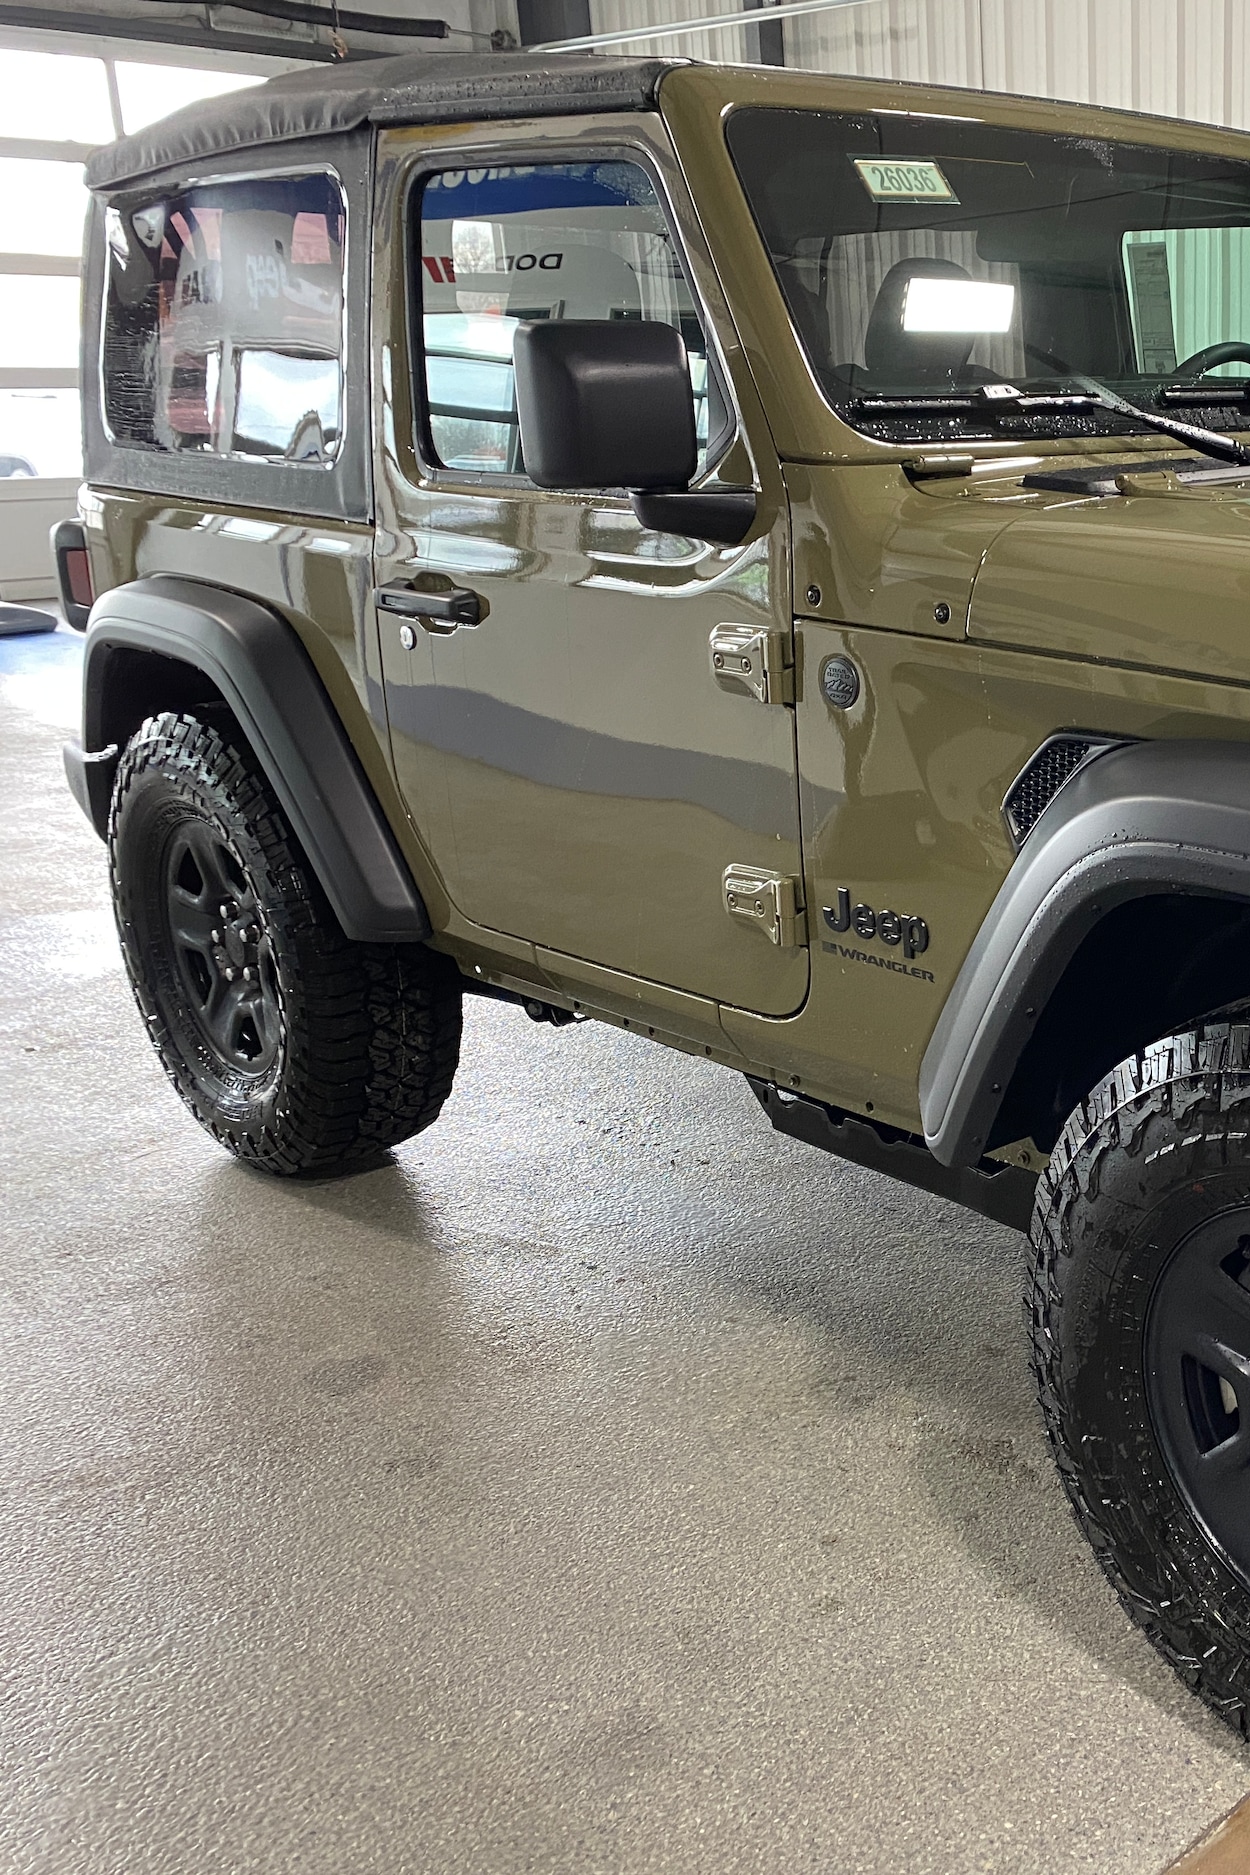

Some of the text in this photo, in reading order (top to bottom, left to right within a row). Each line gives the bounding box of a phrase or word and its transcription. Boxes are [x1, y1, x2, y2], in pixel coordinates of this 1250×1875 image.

[871, 166, 937, 193] 26036
[822, 886, 930, 960] Jeep
[837, 944, 936, 984] WRANGLER
